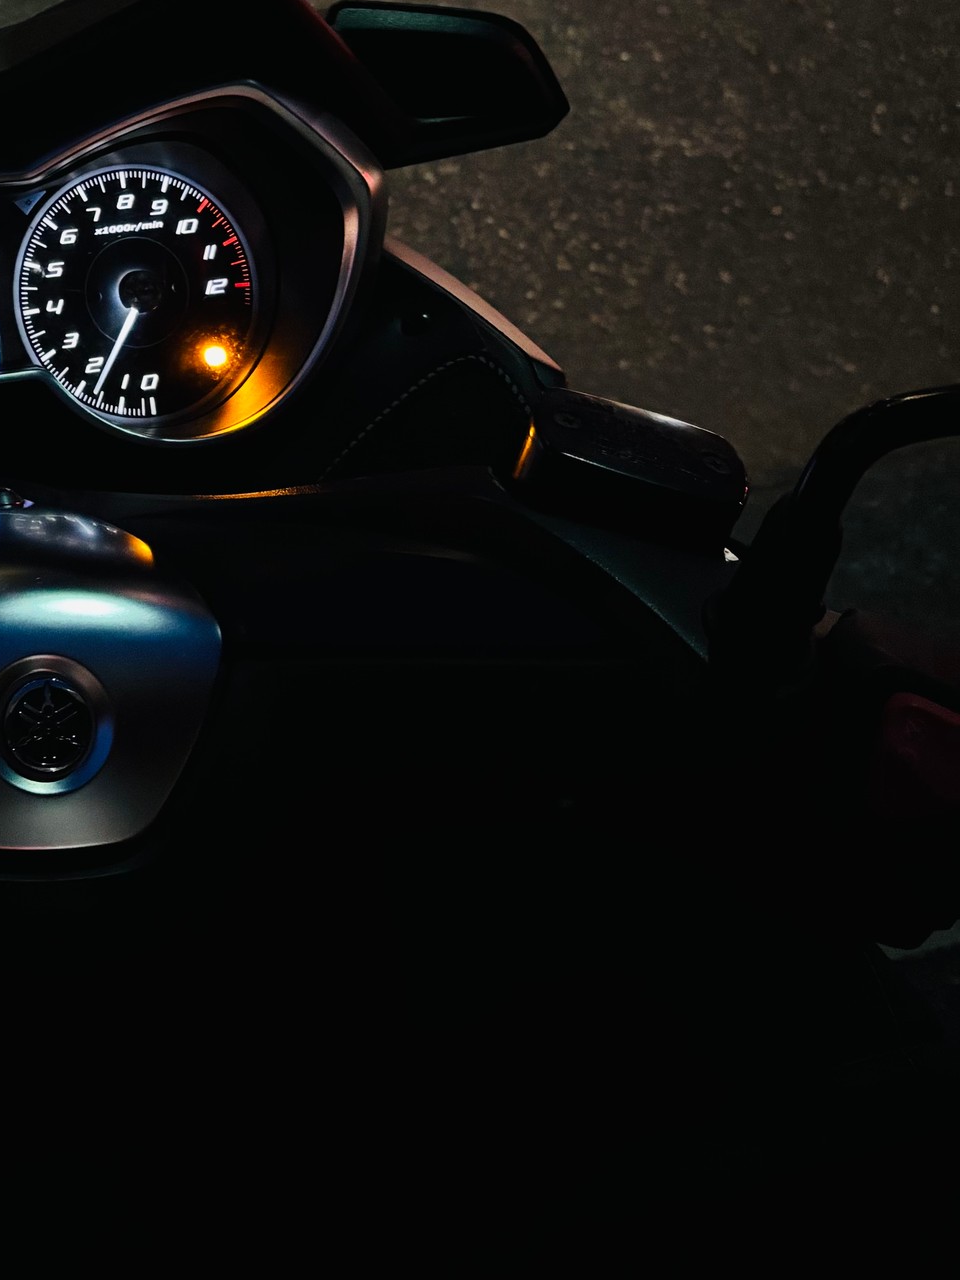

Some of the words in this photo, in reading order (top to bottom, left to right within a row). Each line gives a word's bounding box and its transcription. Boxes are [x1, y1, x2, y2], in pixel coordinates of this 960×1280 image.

[116, 193, 135, 210] 8
[149, 199, 168, 216] 9
[85, 206, 102, 222] 7
[175, 218, 199, 235] 10
[59, 228, 79, 245] 6
[202, 244, 217, 261] 11
[45, 261, 65, 279] 5
[204, 278, 228, 296] 12
[45, 298, 65, 315] 4
[61, 332, 80, 349] 3
[84, 356, 105, 374] 2
[120, 373, 130, 390] 1
[140, 373, 160, 391] 0
